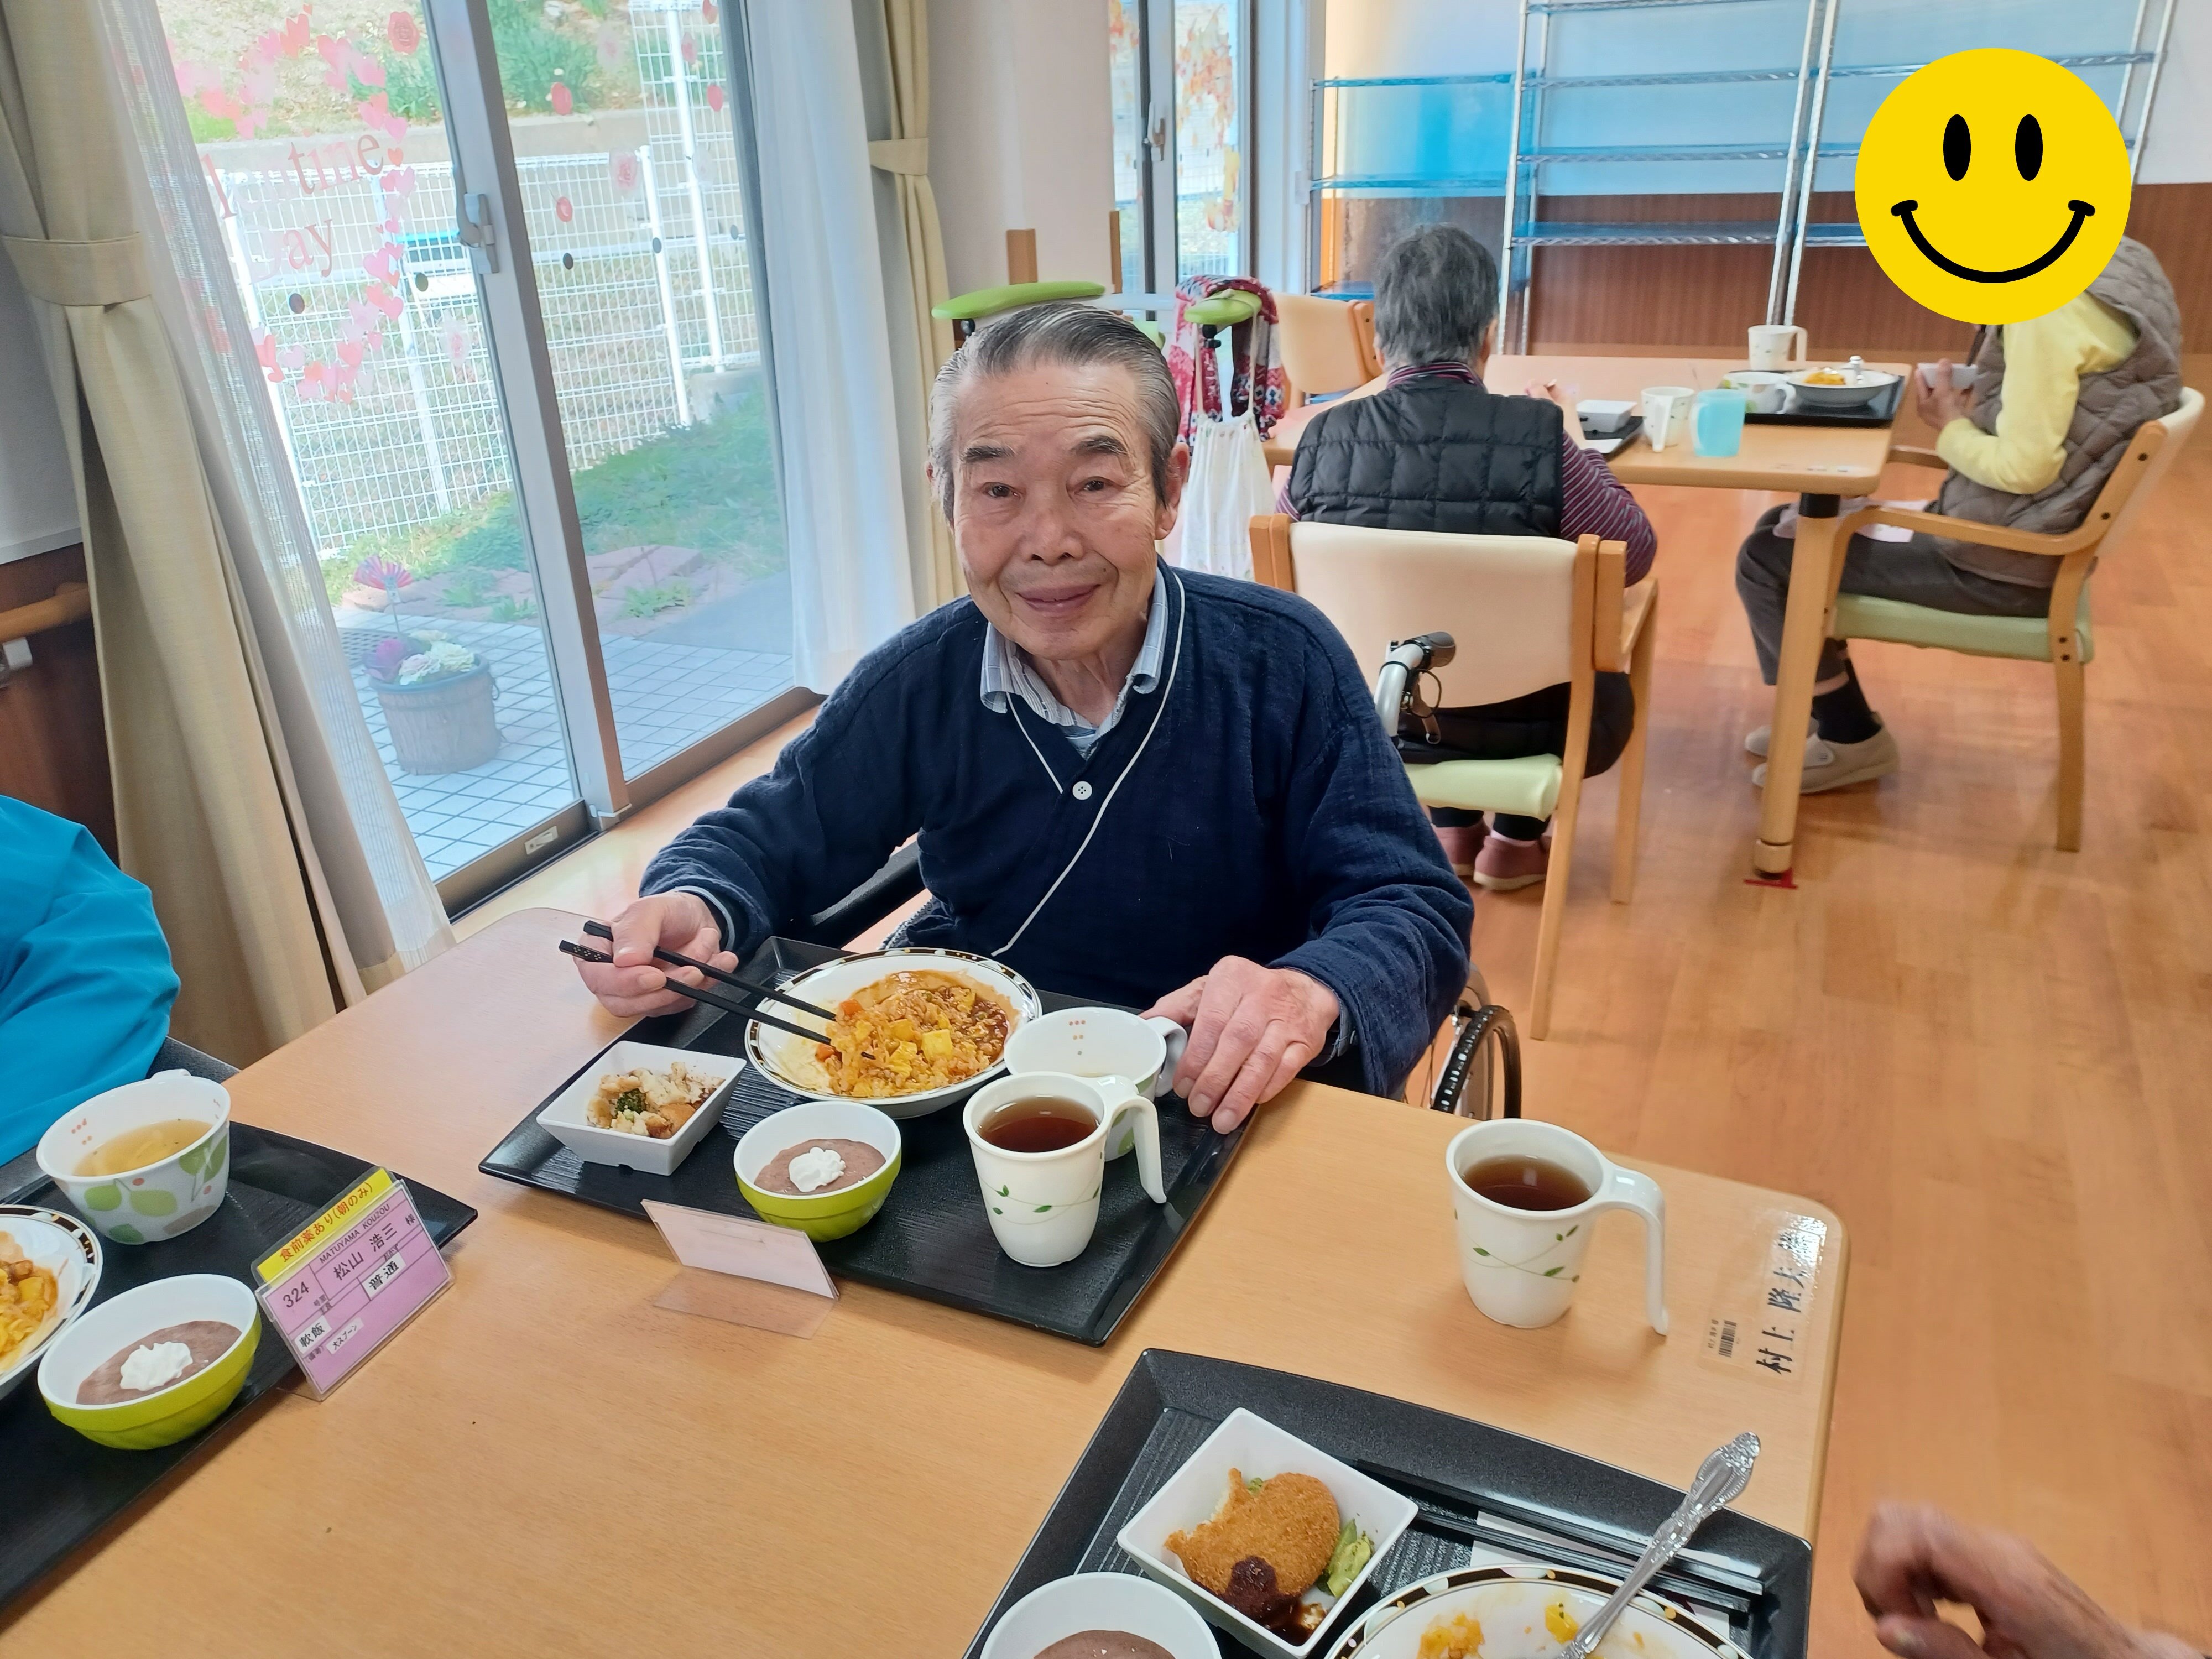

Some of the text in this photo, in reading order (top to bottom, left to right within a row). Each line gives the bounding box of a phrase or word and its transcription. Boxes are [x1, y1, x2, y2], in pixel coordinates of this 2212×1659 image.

[280, 1182, 373, 1262] 食前薬あり(朝のみ)
[320, 1204, 390, 1263] MATUYAMA KOUZOU
[333, 1251, 364, 1280] 松山
[369, 1223, 397, 1252] 浩三
[283, 1281, 309, 1308] 324
[368, 1261, 399, 1290] 普通
[299, 1322, 325, 1347] 軟飯
[1756, 1327, 1795, 1374] 村上
